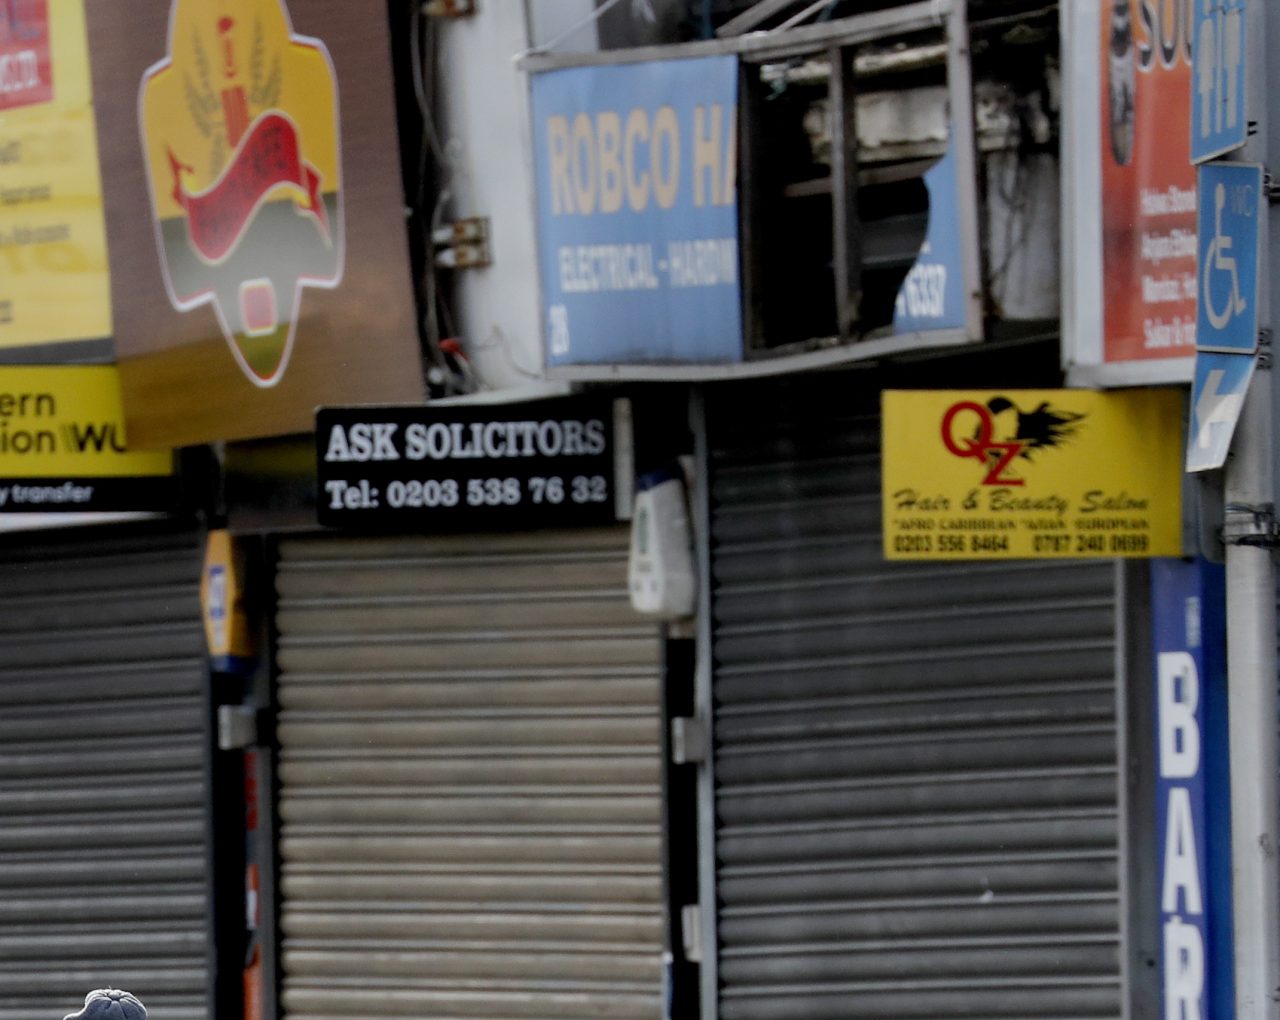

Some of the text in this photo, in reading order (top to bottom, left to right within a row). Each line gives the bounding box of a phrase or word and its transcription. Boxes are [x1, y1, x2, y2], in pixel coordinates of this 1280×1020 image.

[547, 105, 680, 216] ROBCO
[559, 243, 659, 293] ELECTRICAL
[324, 418, 606, 462] ASK SOLICITORS
[12, 482, 95, 503] transfer
[325, 475, 608, 510] Tel: 0203 538 76 32
[893, 488, 954, 512] Hair
[988, 487, 1069, 516] Beauty
[1079, 490, 1149, 513] Salon
[893, 534, 933, 553] 0203
